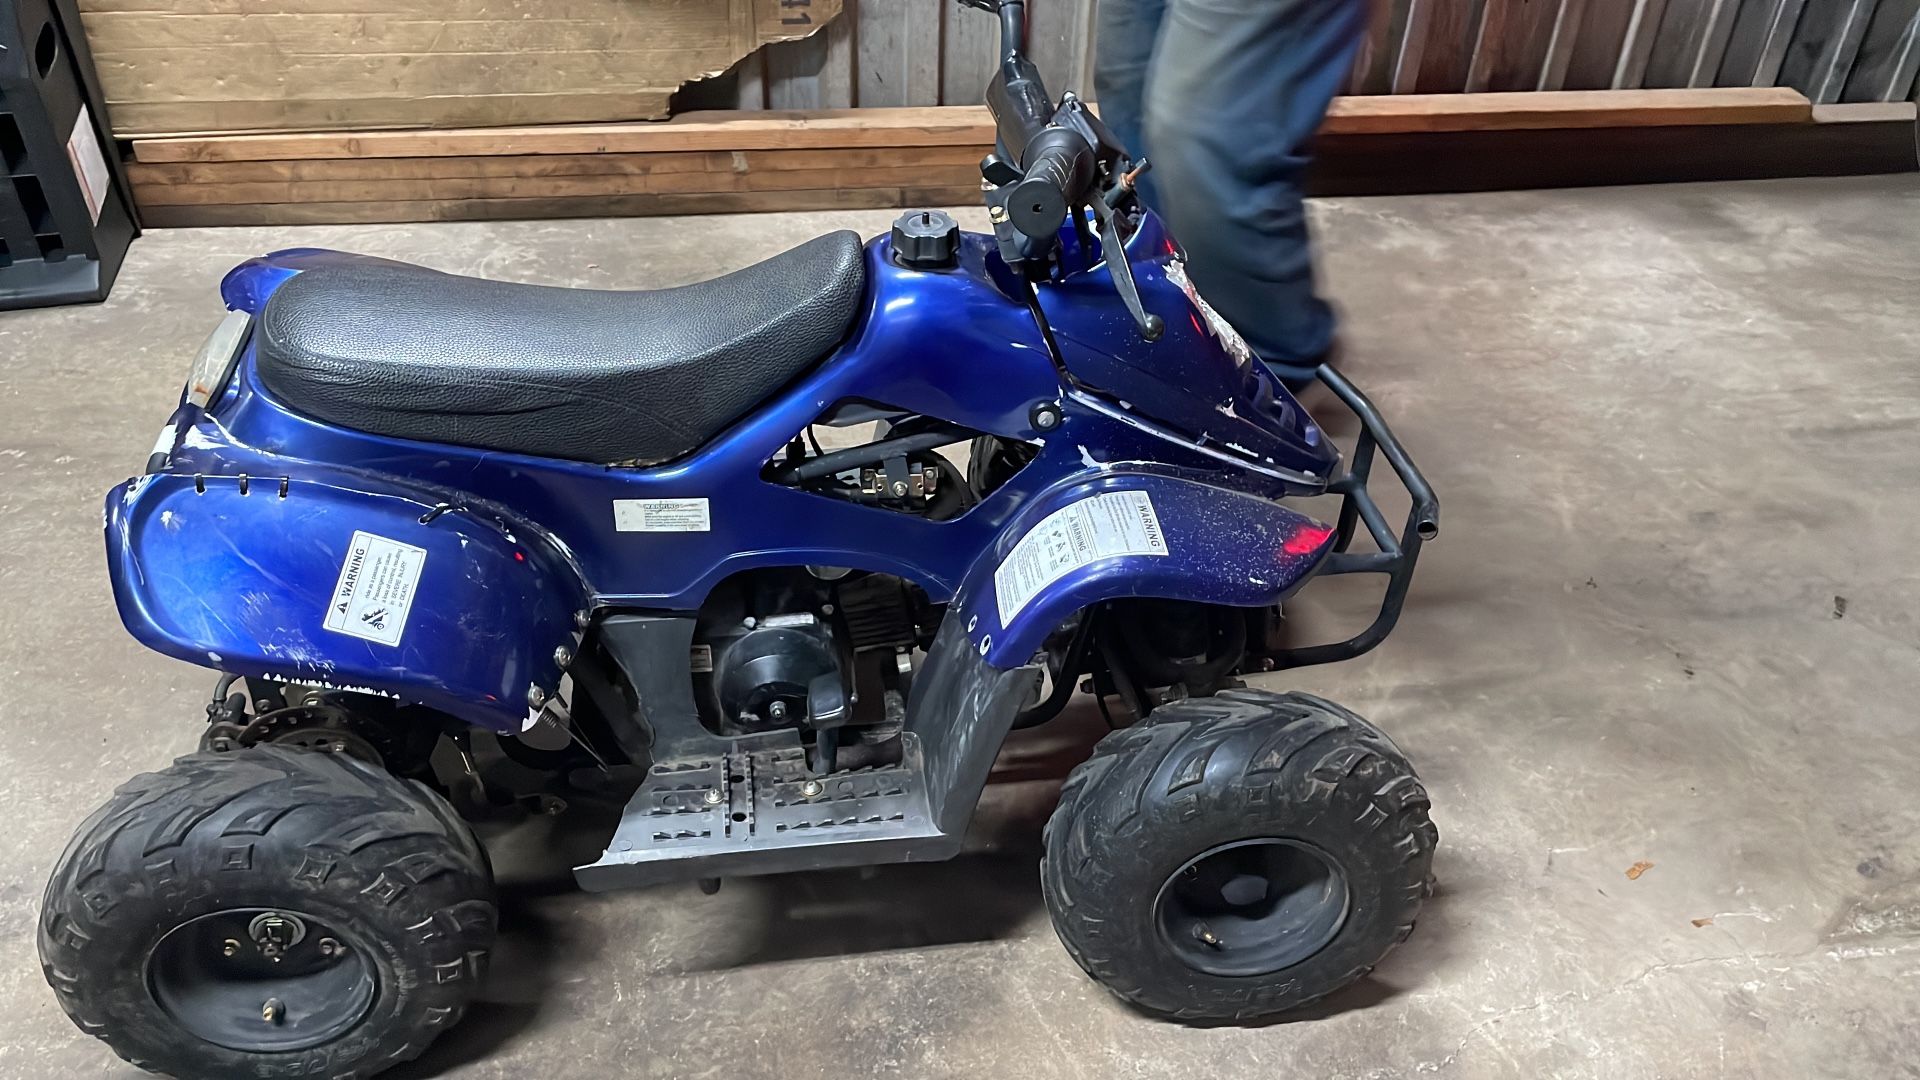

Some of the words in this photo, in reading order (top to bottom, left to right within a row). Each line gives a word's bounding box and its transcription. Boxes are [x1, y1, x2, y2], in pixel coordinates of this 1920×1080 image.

[1072, 522, 1087, 552] WARNING
[1138, 504, 1161, 547] WARNING
[342, 548, 365, 597] WARNING
[373, 574, 385, 601] Passengers
[392, 579, 401, 599] SEVERE
[397, 561, 407, 578] INJURY
